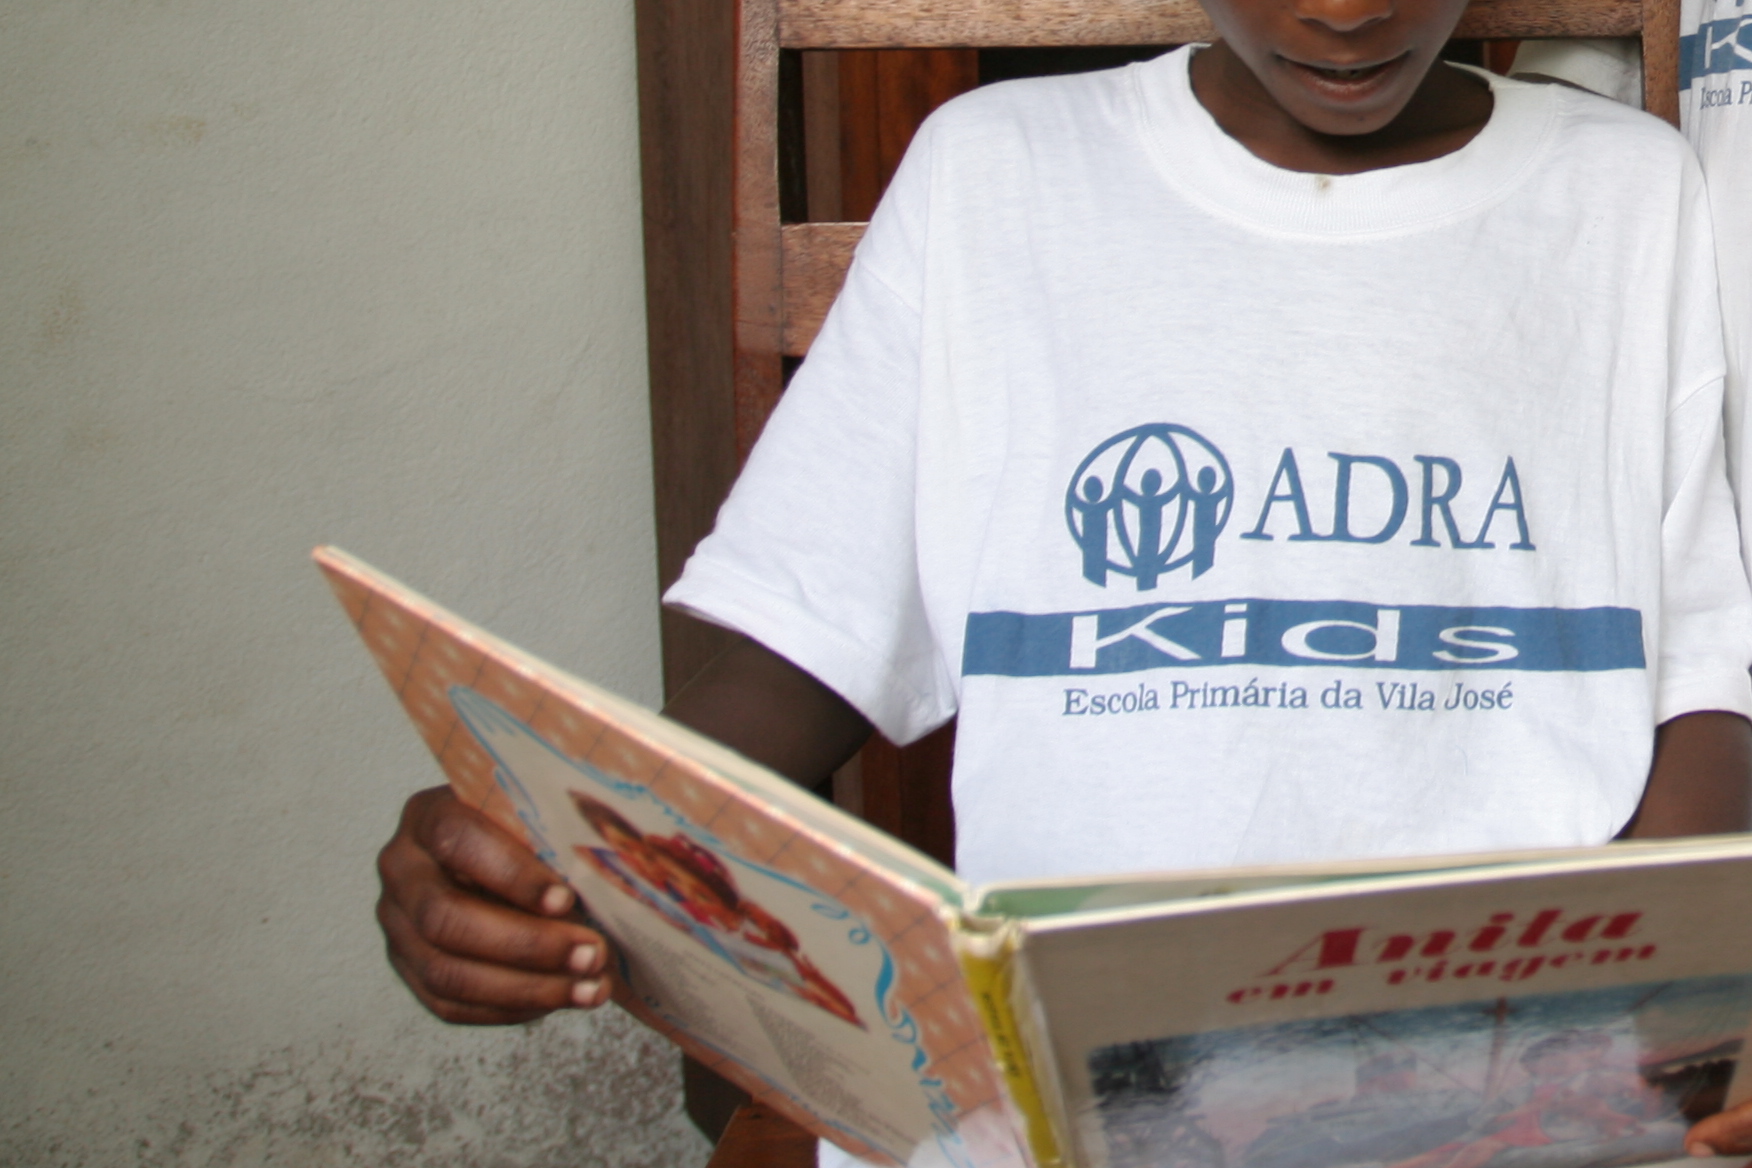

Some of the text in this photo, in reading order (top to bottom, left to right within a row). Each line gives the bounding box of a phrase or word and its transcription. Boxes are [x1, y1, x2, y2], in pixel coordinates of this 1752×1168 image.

[1239, 446, 1537, 552] ADRA
[1068, 603, 1521, 670] Kids
[1061, 678, 1515, 717] Escola Primária da Vila José
[1225, 942, 1659, 1007] em viagem
[1260, 907, 1647, 980] Anita
